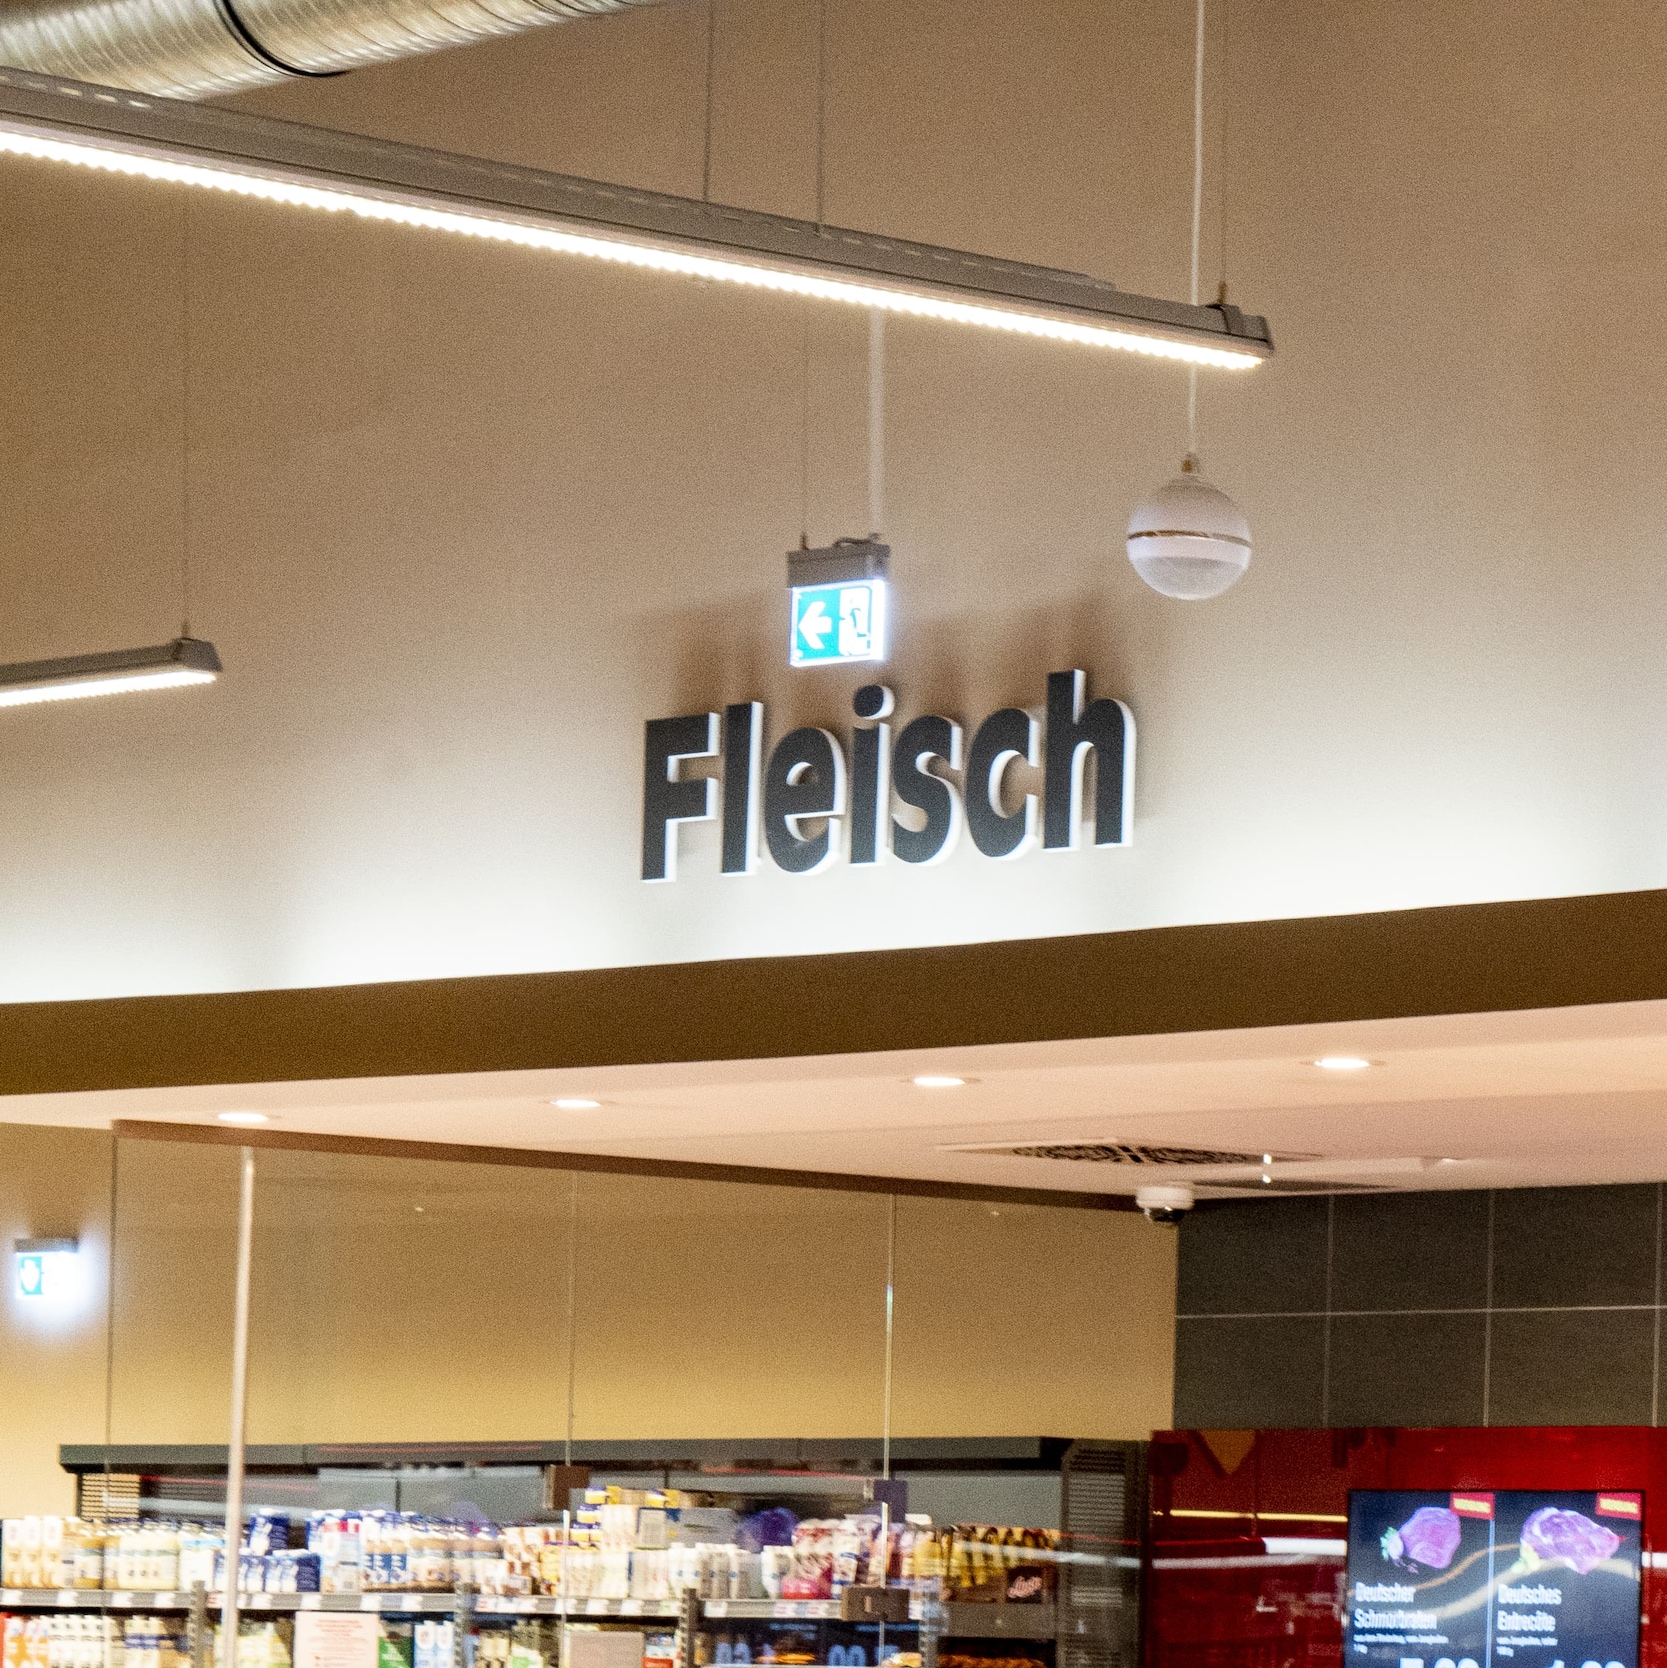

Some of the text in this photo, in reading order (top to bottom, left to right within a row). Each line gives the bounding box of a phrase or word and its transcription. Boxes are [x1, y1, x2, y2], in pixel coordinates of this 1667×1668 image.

[641, 669, 1137, 883] Fleisch
[1355, 1581, 1416, 1604] Deutscher
[1497, 1584, 1562, 1606] Deutsches
[1354, 1608, 1438, 1629] Schmorbraten
[1496, 1610, 1556, 1633] Entrecôte
